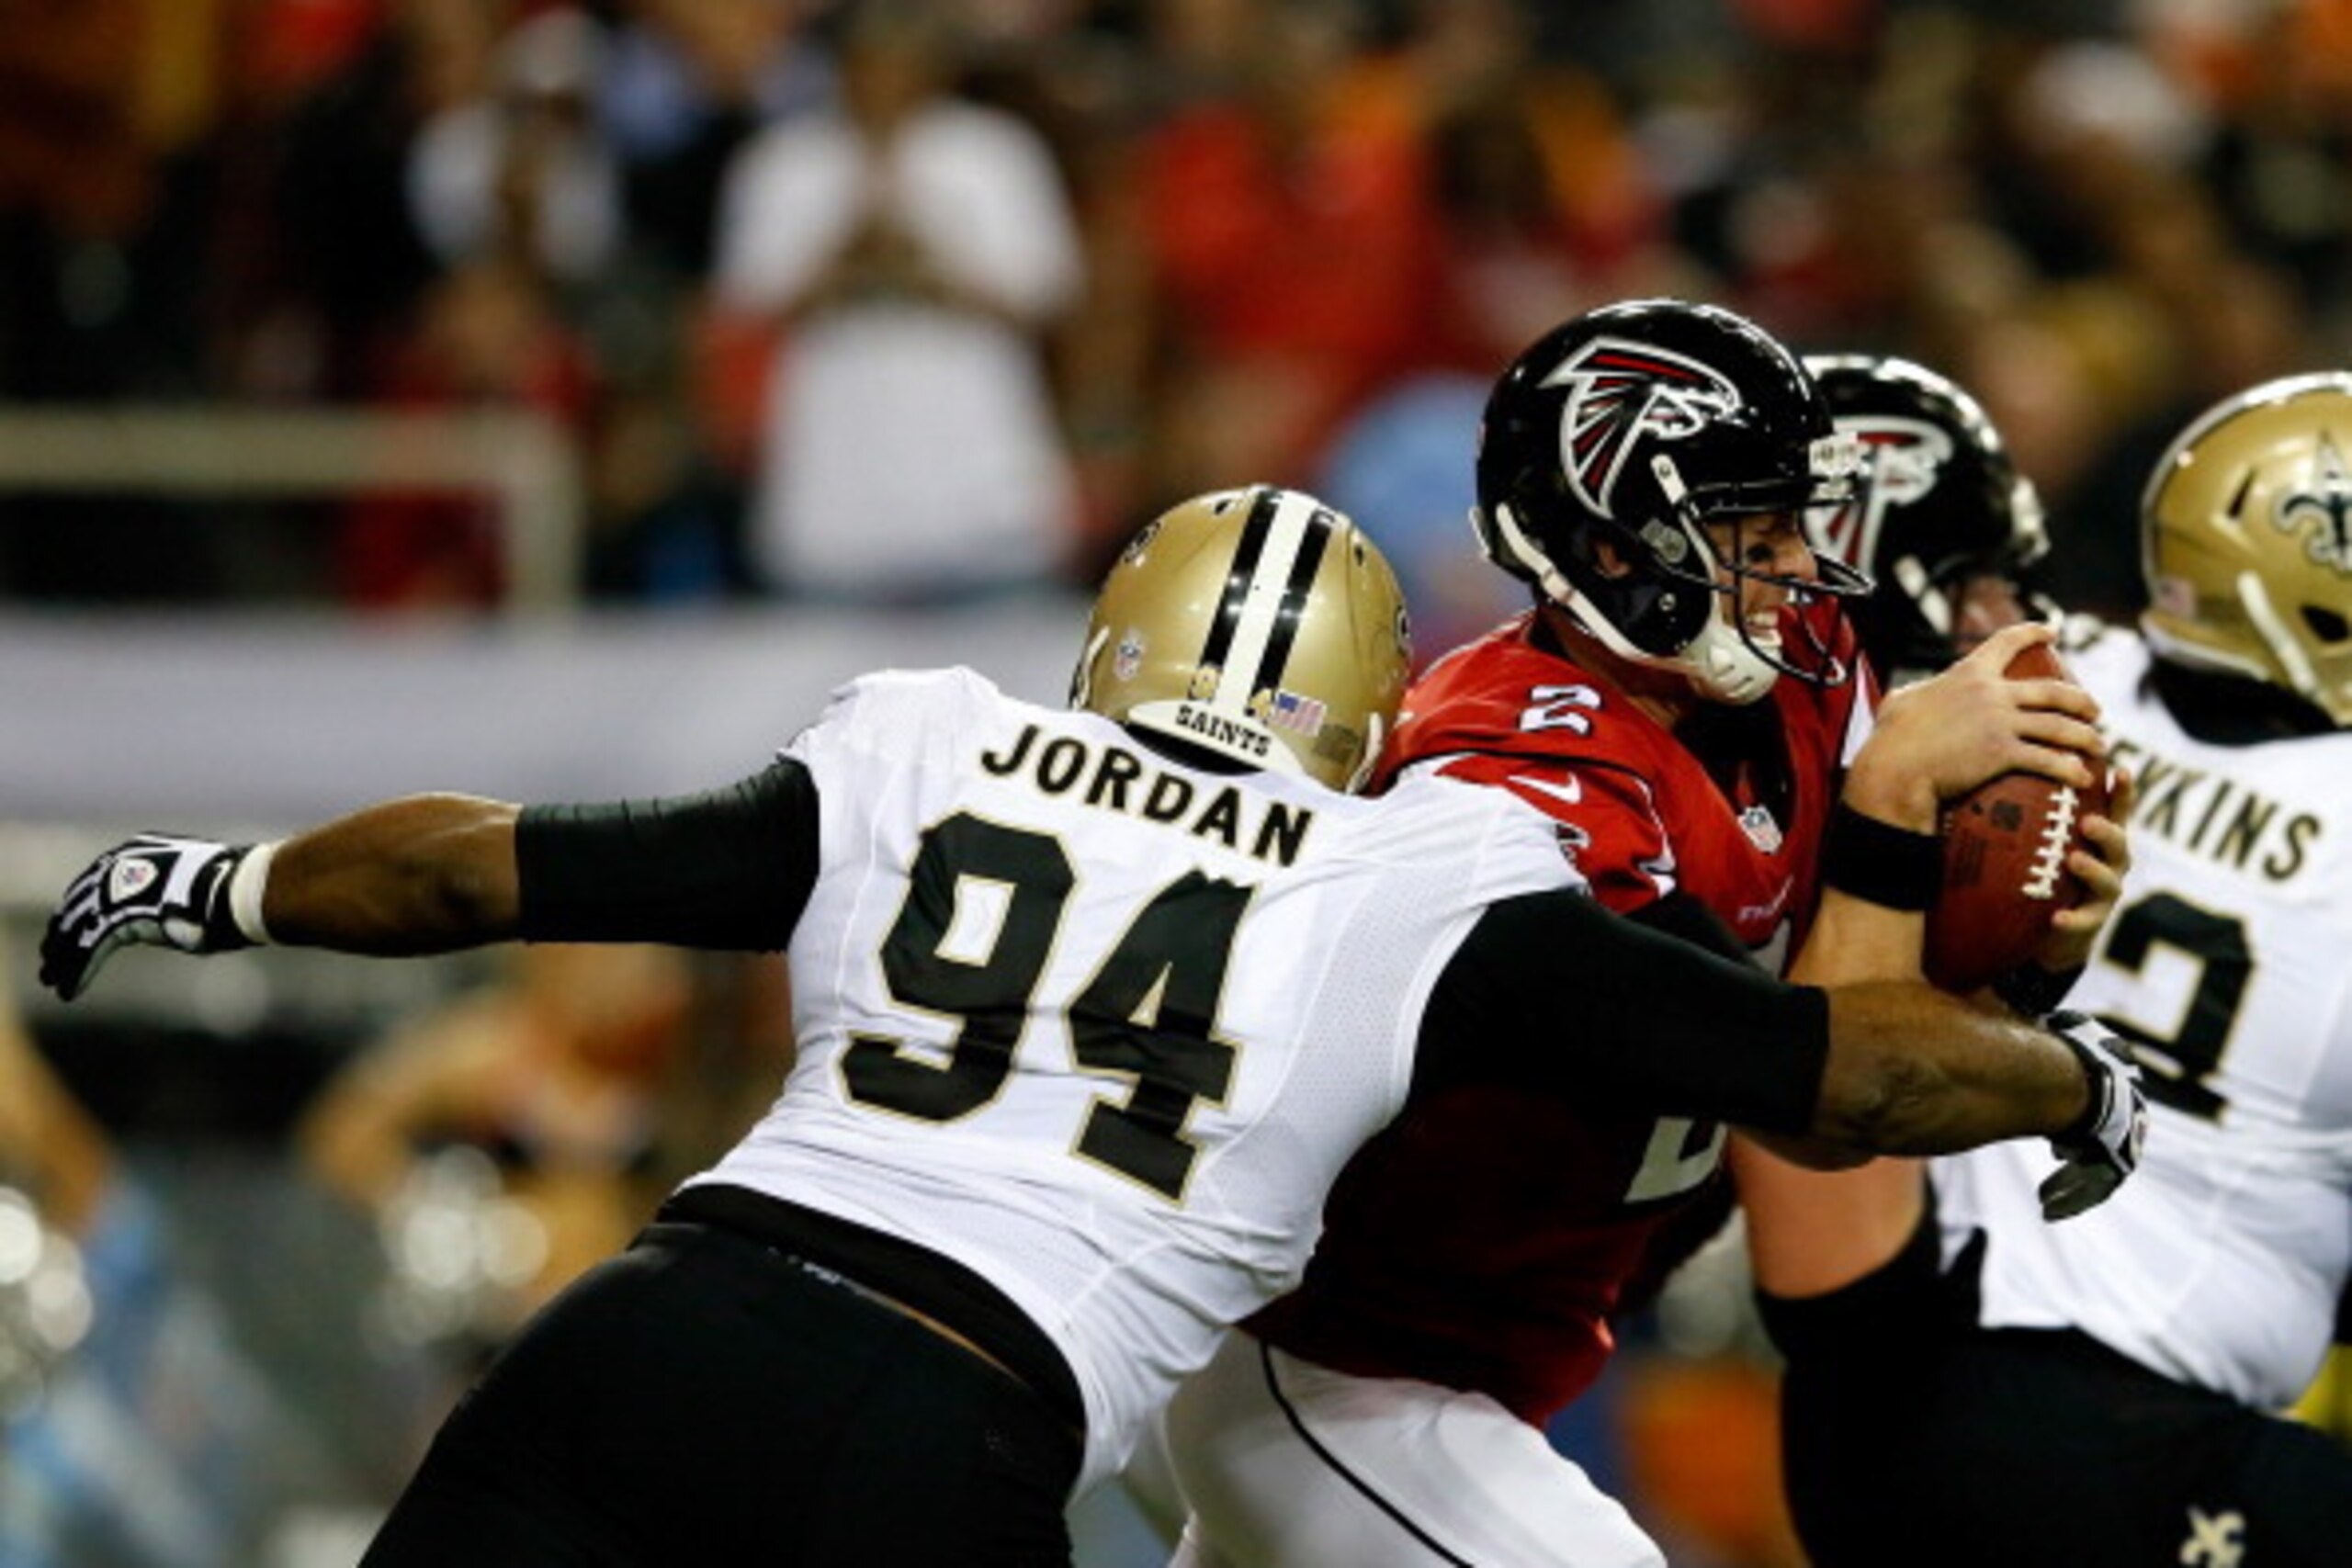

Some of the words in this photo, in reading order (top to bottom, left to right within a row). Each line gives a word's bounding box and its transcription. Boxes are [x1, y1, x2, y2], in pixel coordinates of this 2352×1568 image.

[1176, 705, 1270, 757] SAINTS
[1519, 684, 1600, 735] 2
[981, 725, 1313, 867] JORDAN
[838, 810, 1259, 1207] 94
